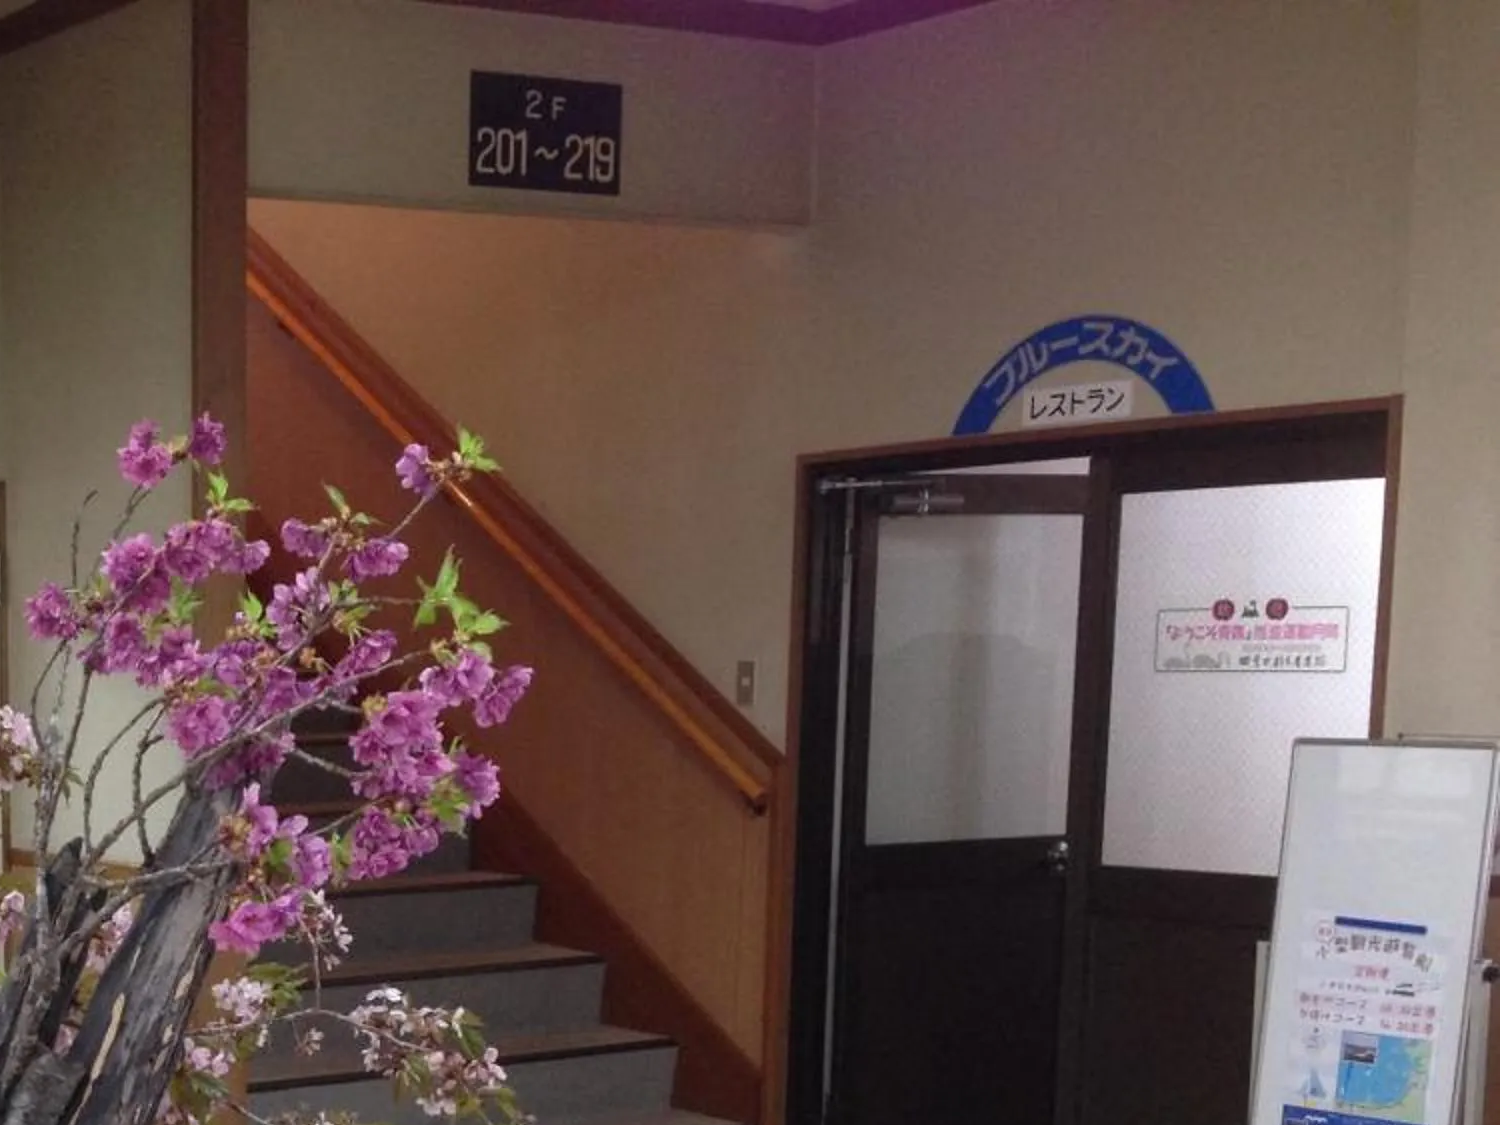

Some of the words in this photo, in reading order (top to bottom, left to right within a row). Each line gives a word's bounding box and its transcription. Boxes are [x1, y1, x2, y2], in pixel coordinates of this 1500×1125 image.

[1029, 388, 1125, 419] レストラン
